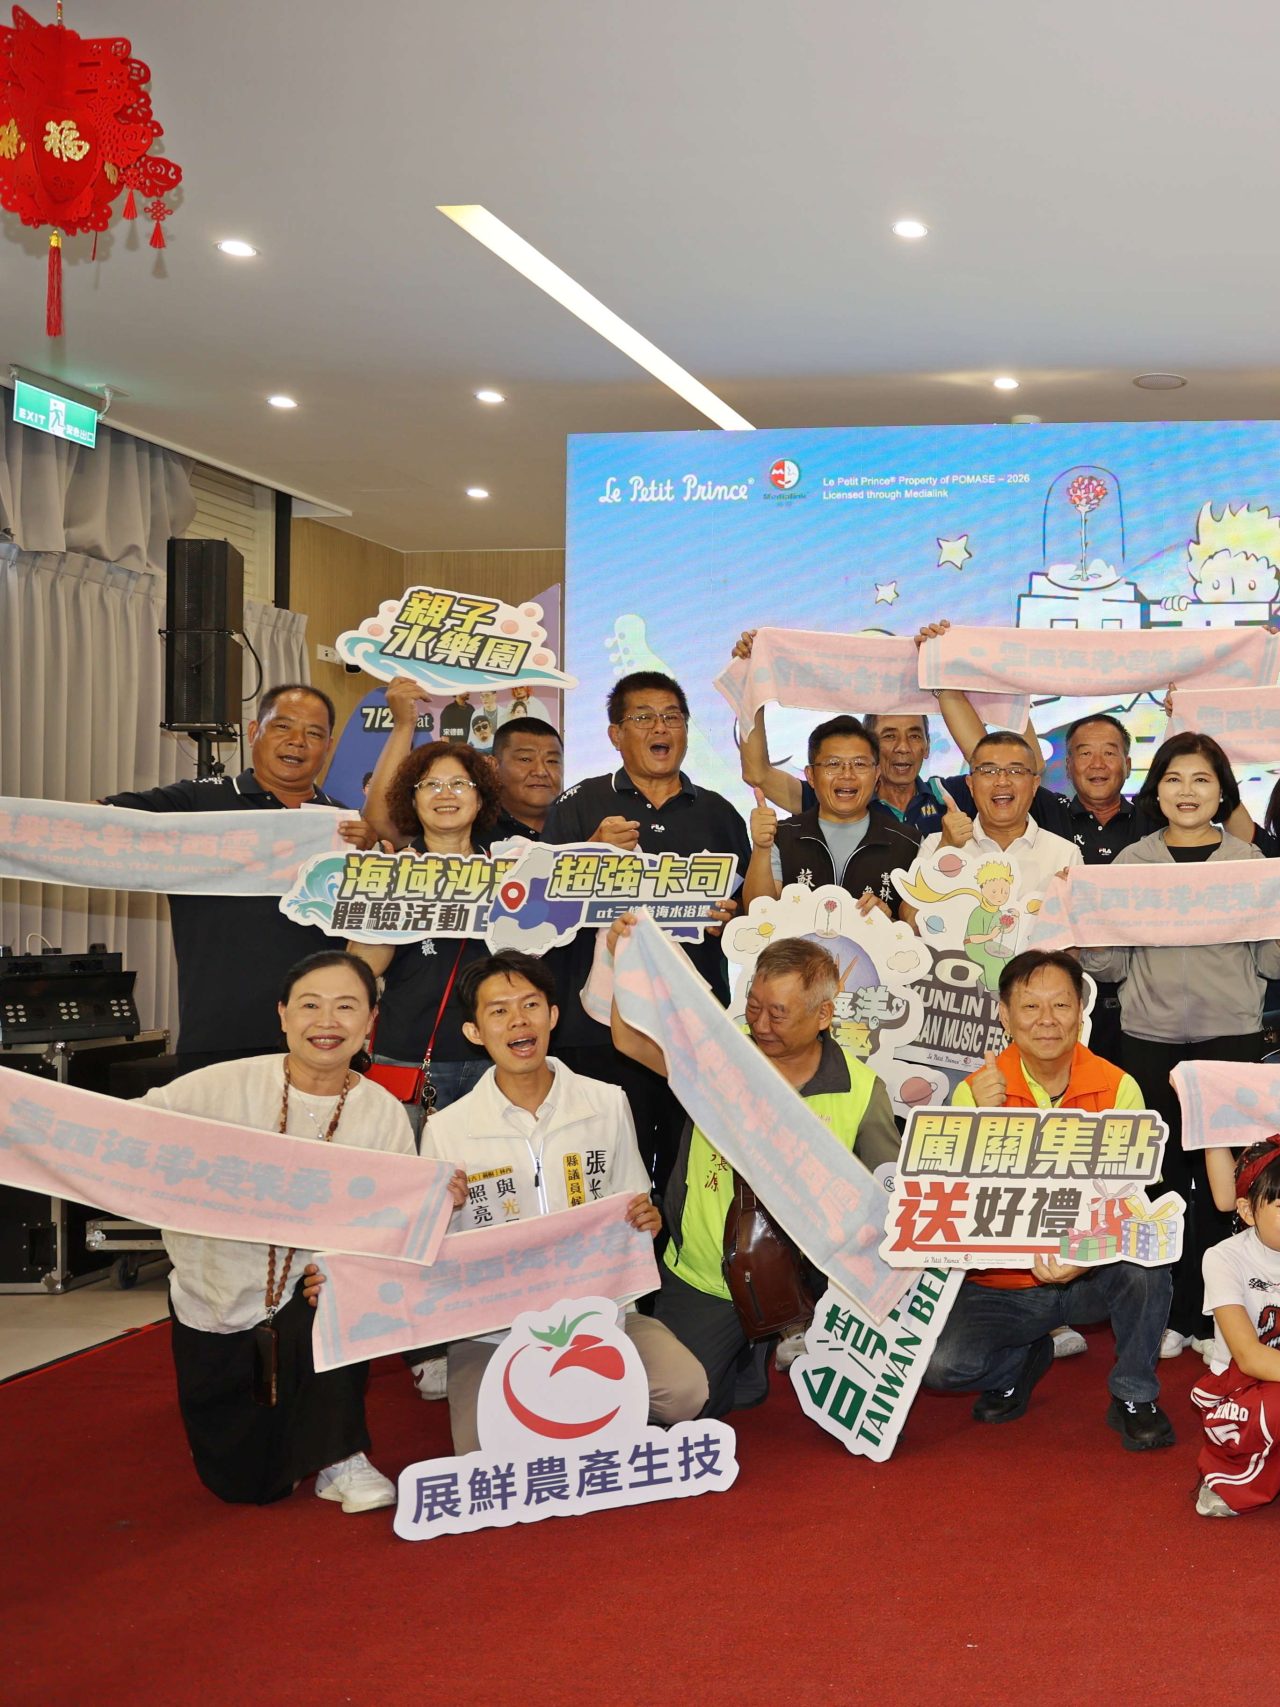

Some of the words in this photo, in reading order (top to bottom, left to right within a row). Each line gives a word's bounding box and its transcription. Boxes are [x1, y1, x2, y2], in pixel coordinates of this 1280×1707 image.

[18, 407, 46, 424] EXIT
[598, 476, 622, 503] Le
[628, 475, 675, 502] Petit
[822, 477, 835, 487] Le
[837, 477, 859, 487] Petit
[898, 475, 938, 487] Property
[940, 475, 950, 485] of
[952, 474, 995, 484] POMASE
[1006, 474, 1030, 484] 2026
[822, 490, 864, 500] Licensed
[866, 490, 902, 501] through
[904, 489, 949, 499] Medialink
[399, 588, 499, 634] 親子
[380, 625, 531, 676] 水樂園
[361, 707, 395, 729] 7/2
[548, 854, 734, 898] 超強卡司
[330, 900, 470, 932] 體驗活動
[940, 1017, 985, 1053] MUSIC
[904, 1113, 1161, 1177] 闖關集點
[889, 1180, 1085, 1254] 送好禮
[855, 1325, 922, 1448] TAIWAN
[907, 1267, 951, 1326] BE
[411, 1432, 724, 1525] 展鮮農產生技
